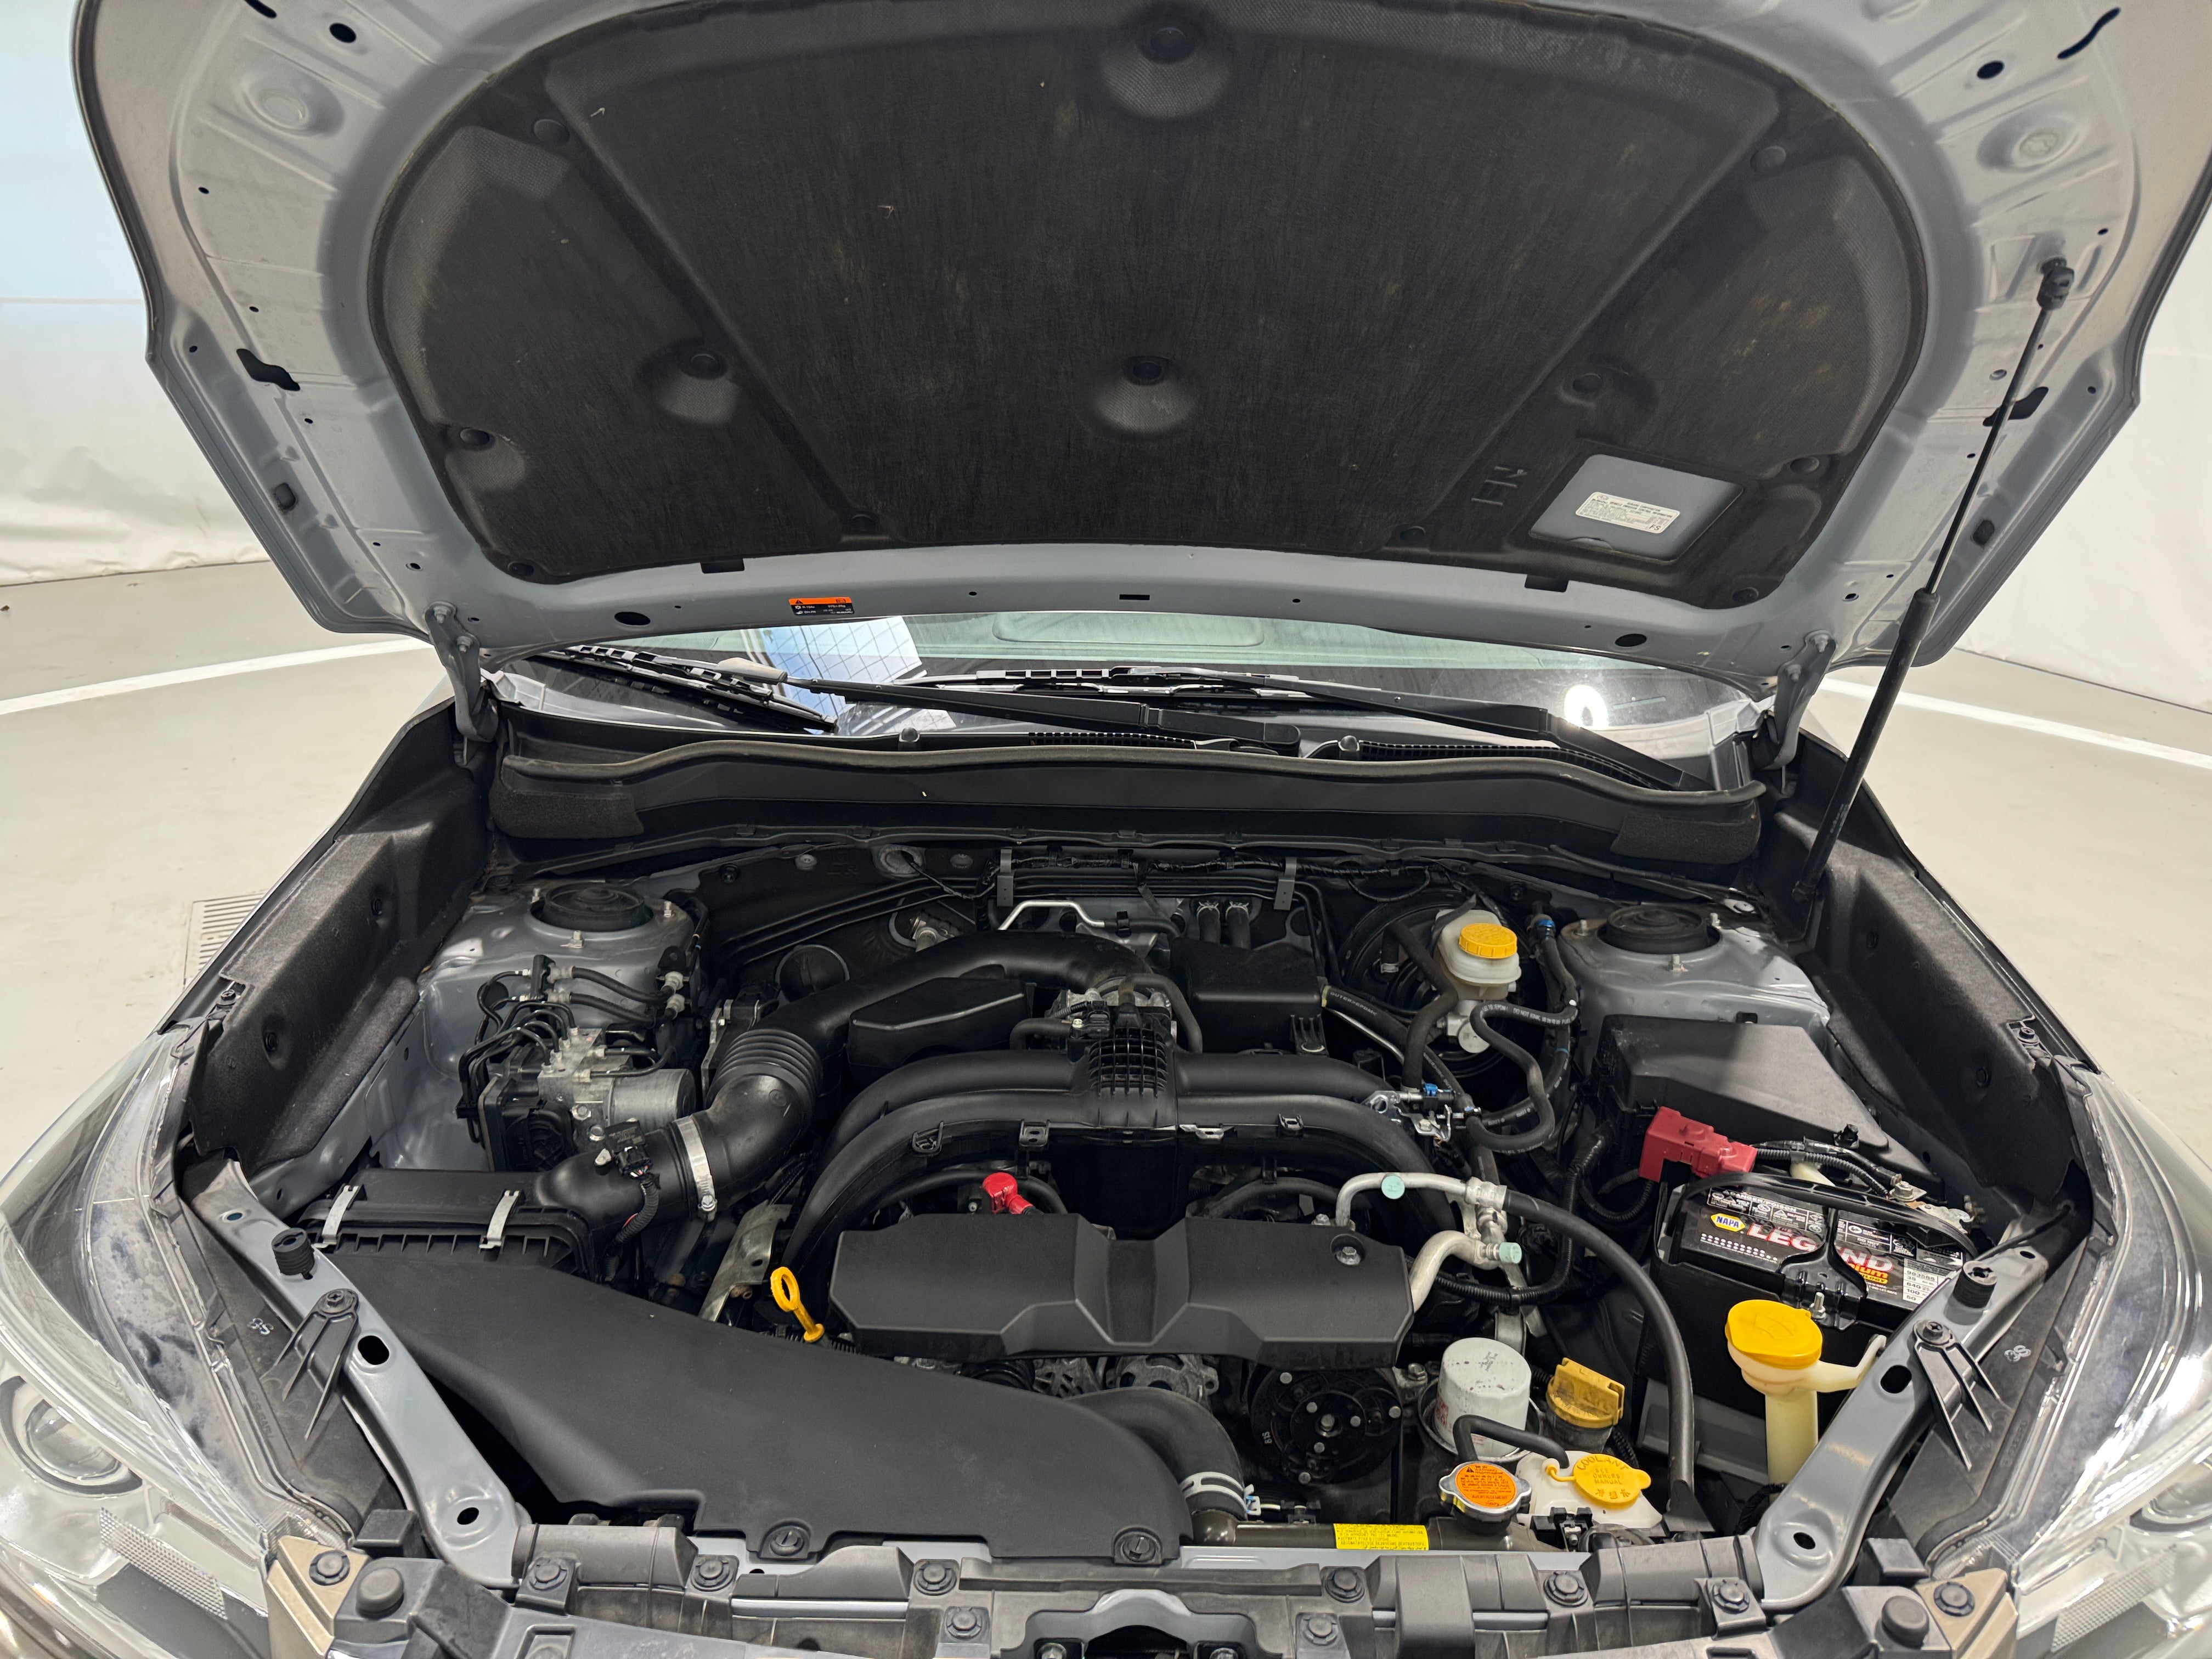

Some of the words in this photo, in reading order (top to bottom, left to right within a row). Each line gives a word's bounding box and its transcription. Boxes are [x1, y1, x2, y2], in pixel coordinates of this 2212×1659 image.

[1730, 1191, 1797, 1212] DANGER/POISON
[1716, 1216, 1739, 1228] NAPA
[1577, 1455, 1629, 1470] COOLANT
